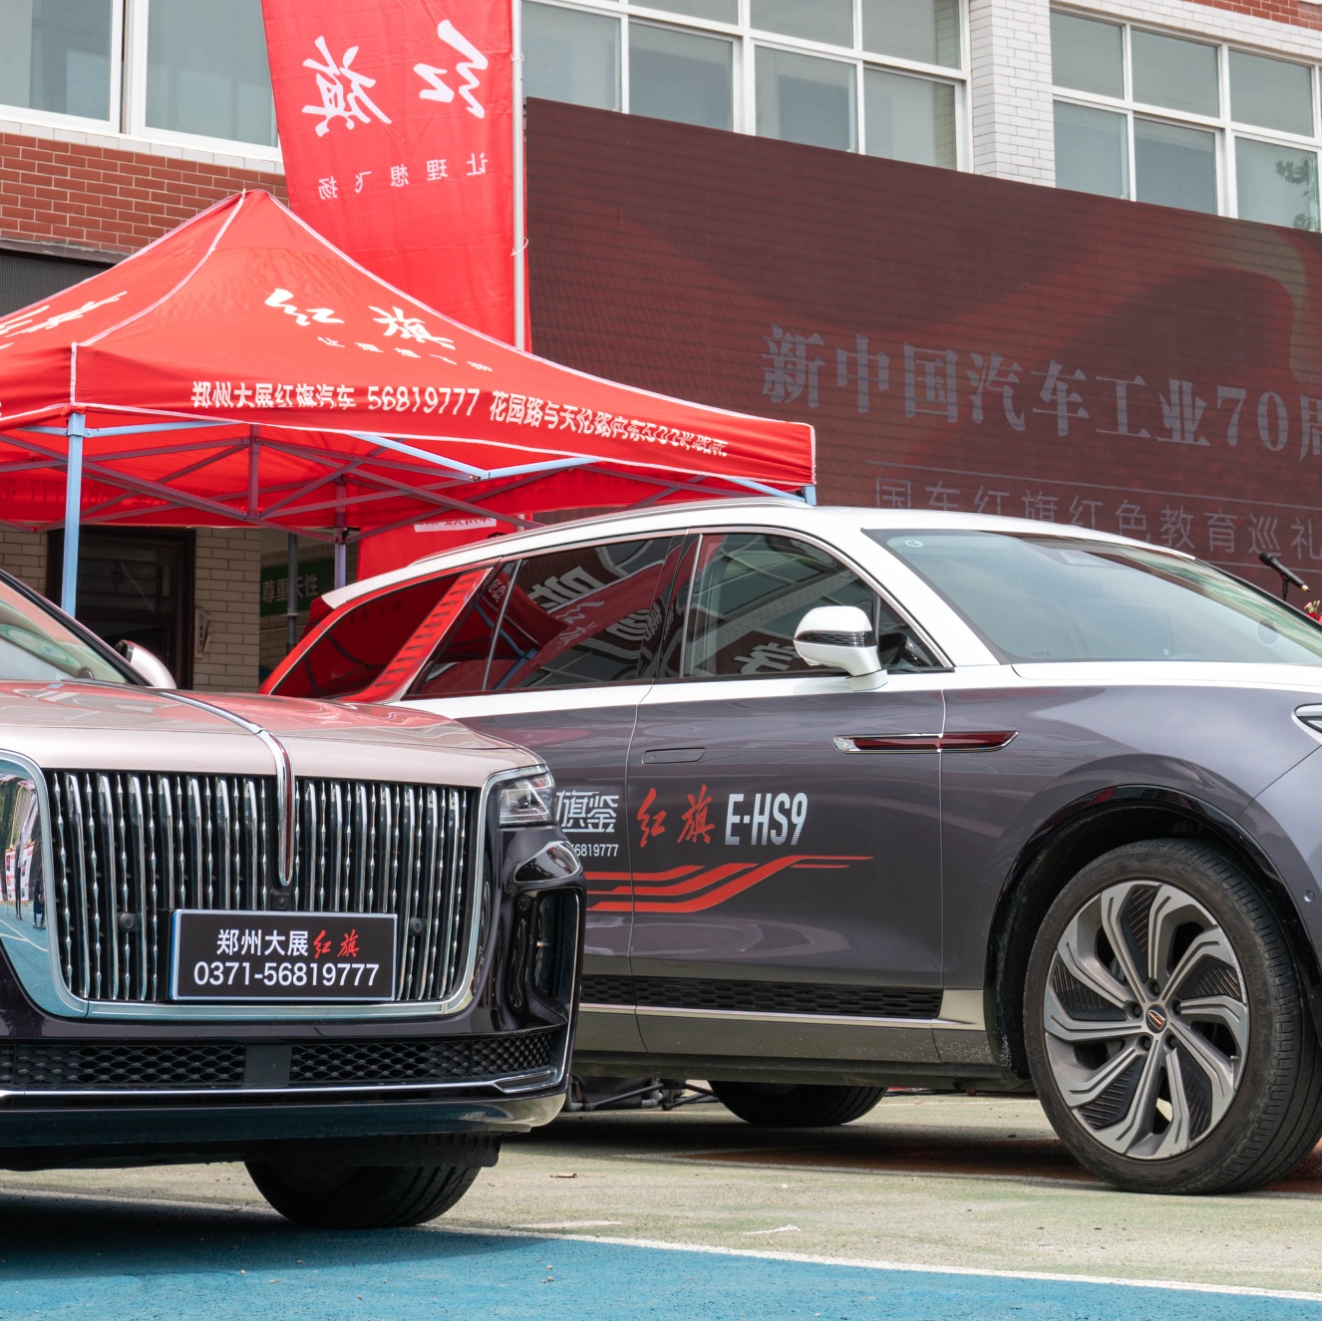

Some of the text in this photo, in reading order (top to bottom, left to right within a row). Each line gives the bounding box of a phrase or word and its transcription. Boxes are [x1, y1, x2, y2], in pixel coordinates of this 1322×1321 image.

[190, 380, 356, 410] 郑州大展红旗汽车
[367, 385, 480, 416] 56819777
[193, 961, 379, 986] 0371-56819777
